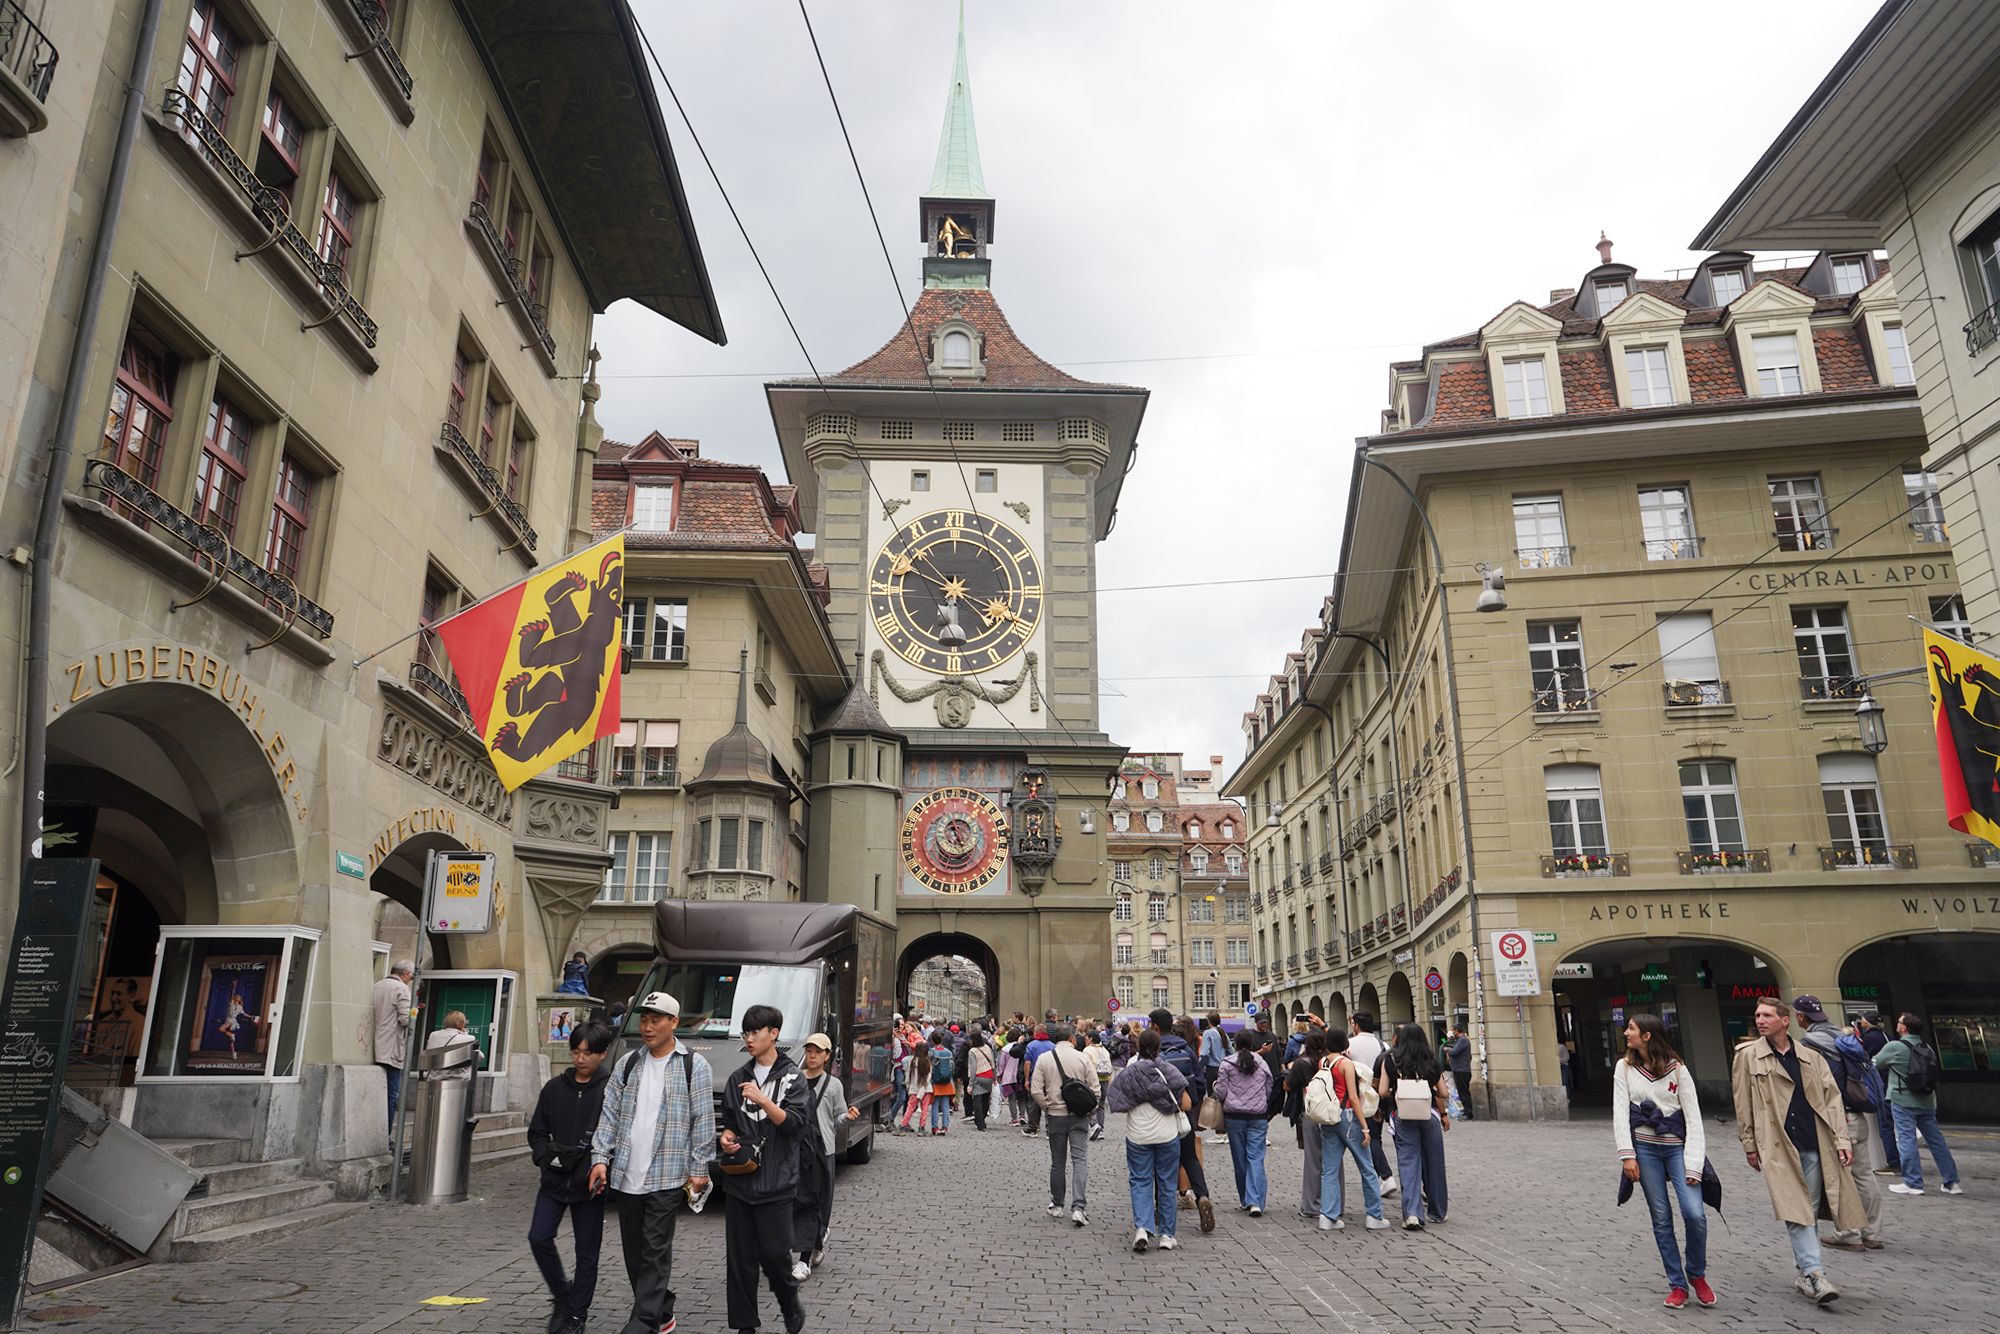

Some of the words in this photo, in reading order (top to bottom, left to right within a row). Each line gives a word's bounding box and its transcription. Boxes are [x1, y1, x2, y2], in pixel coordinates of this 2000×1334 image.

[944, 511, 965, 527] XII
[1013, 547, 1030, 563] II
[1749, 568, 1865, 590] CENTRAL
[1885, 563, 1950, 583] APOT
[1024, 584, 1041, 599] III
[1589, 902, 1730, 920] APOTHEKE
[1844, 986, 1879, 997] HEKE
